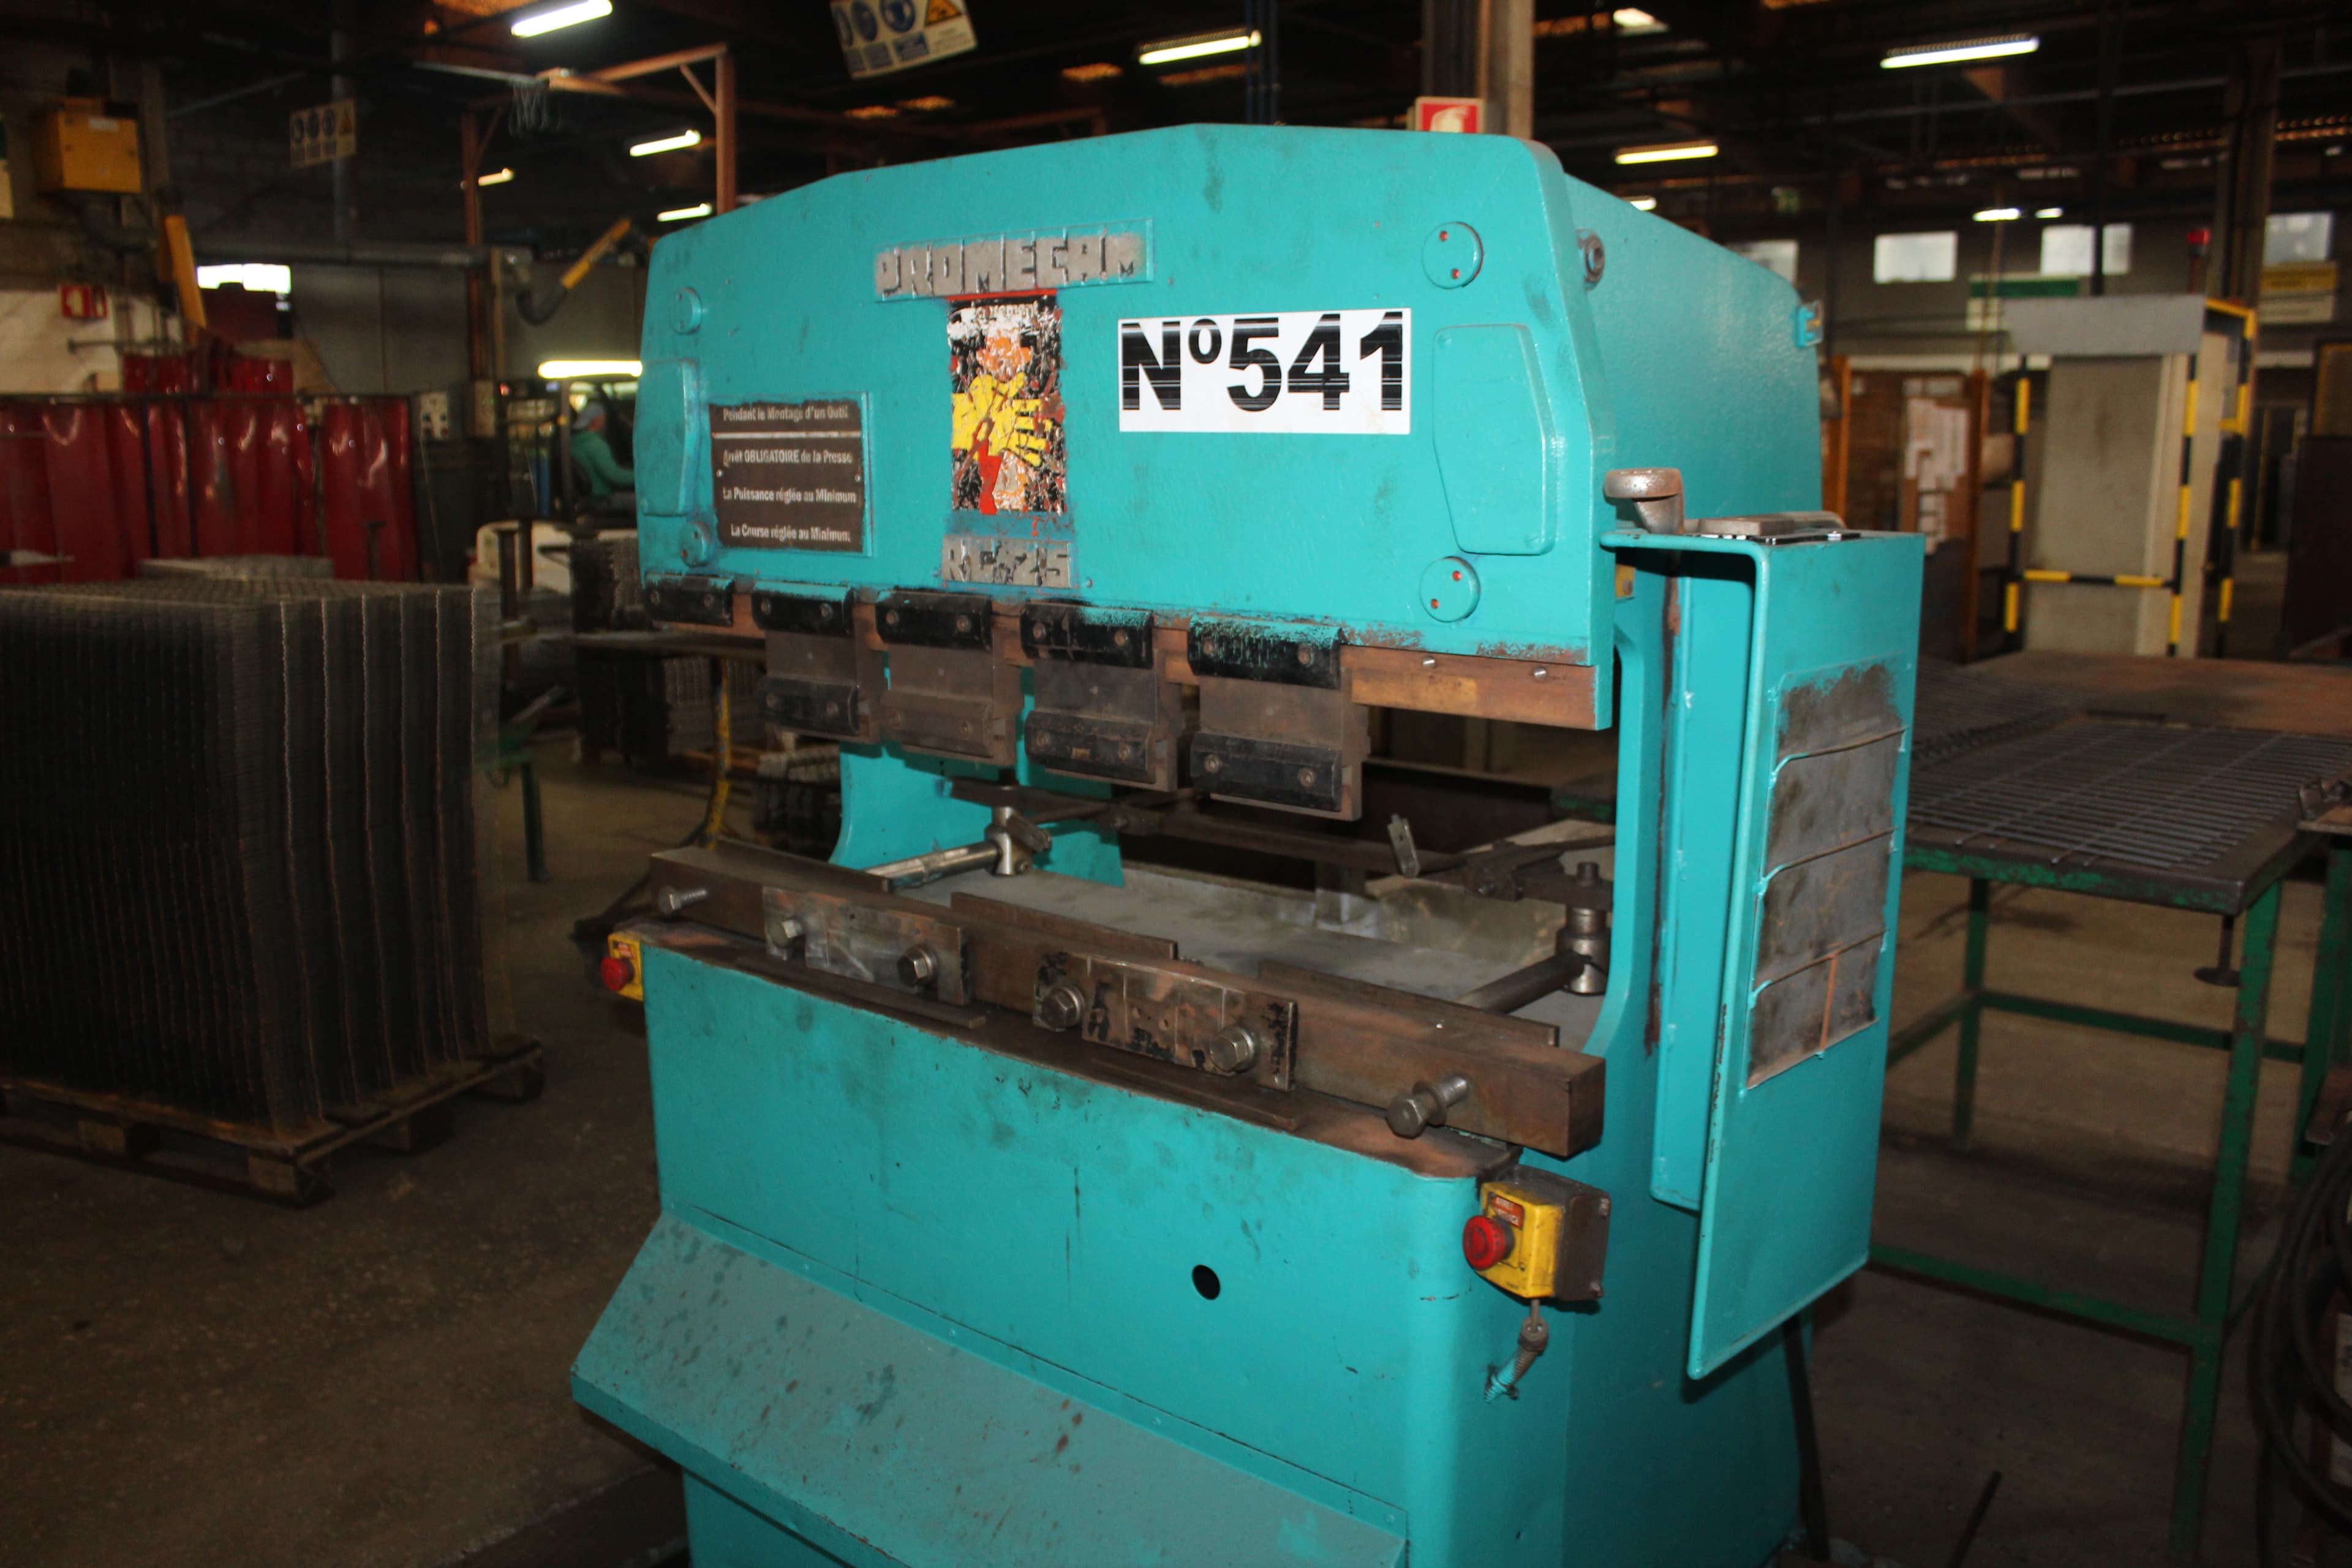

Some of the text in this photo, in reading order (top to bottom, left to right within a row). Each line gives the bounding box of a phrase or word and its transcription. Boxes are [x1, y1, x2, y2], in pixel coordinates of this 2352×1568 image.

[723, 404, 848, 423] Pendant le Montage d'un Outil
[744, 449, 799, 463] OBLIGATOIRE
[801, 450, 811, 464] de
[813, 450, 822, 464] la
[823, 450, 853, 464] Presse
[723, 487, 856, 504] La Puissance réglée au Minimum
[731, 524, 850, 543] La Course réglée au Minimum
